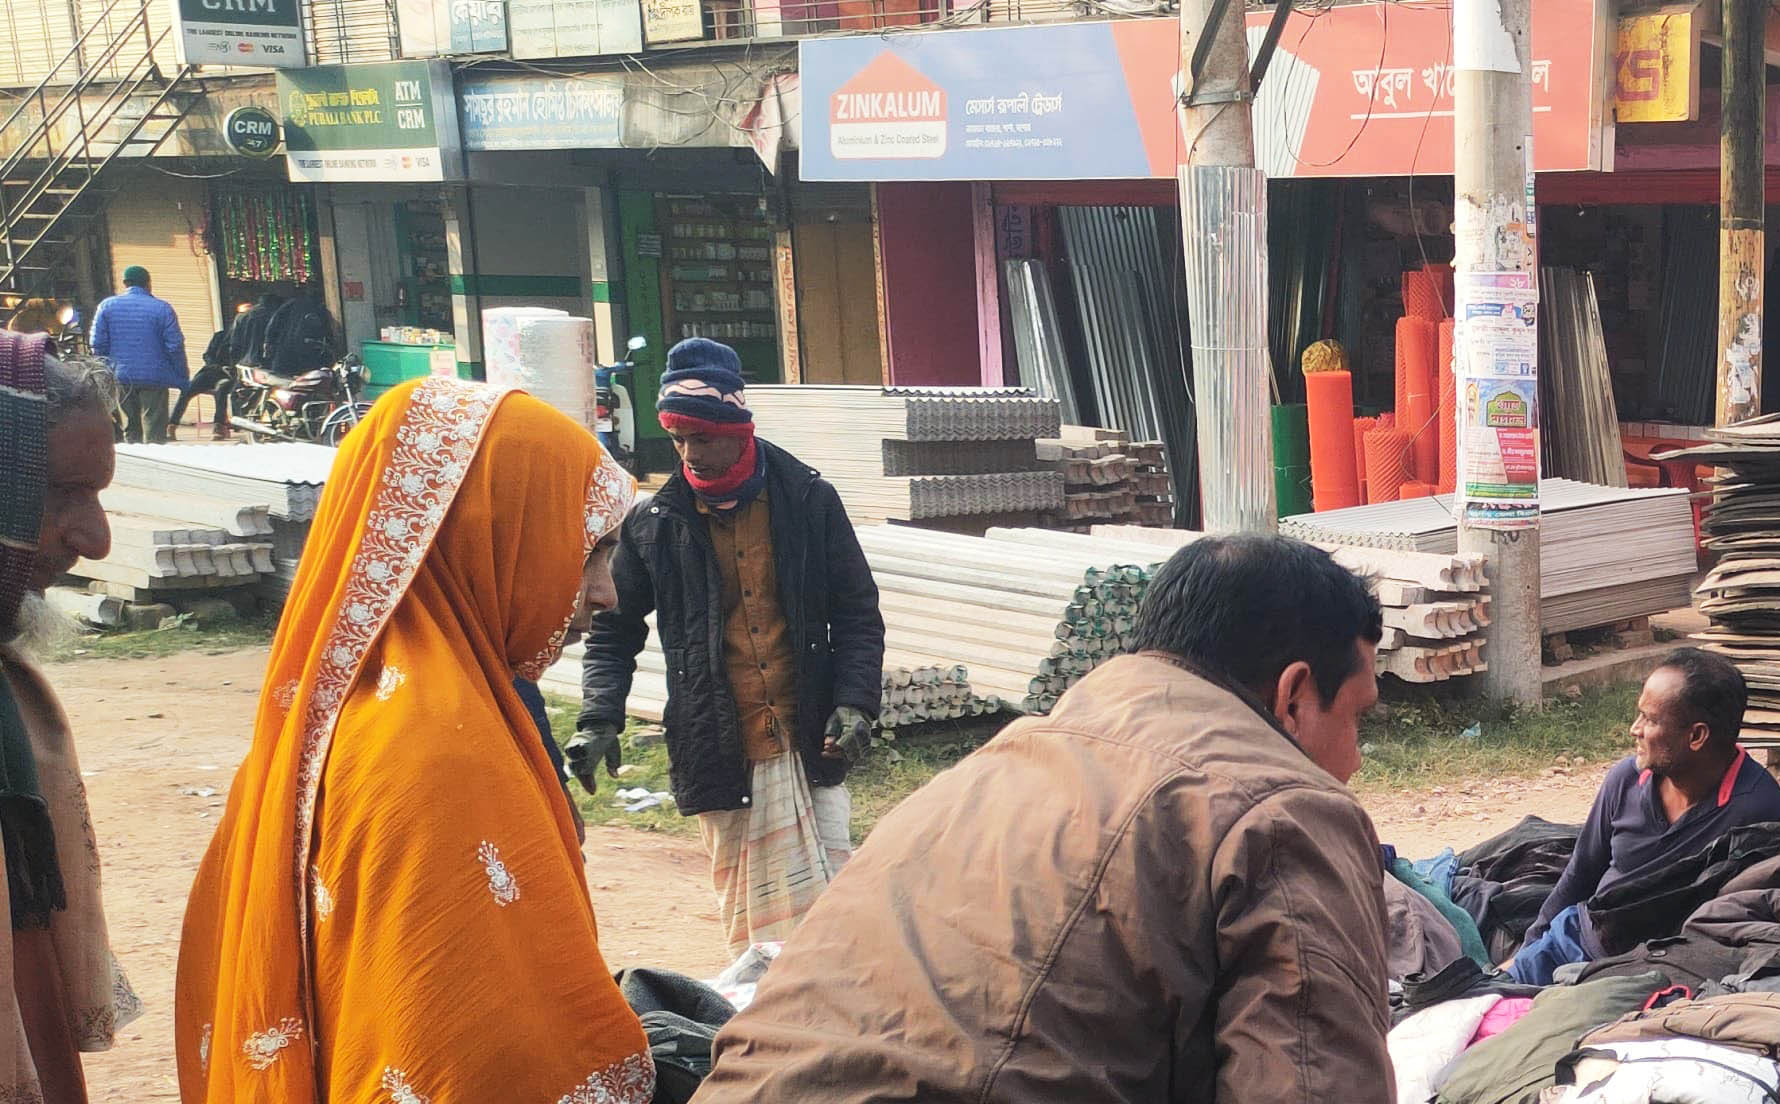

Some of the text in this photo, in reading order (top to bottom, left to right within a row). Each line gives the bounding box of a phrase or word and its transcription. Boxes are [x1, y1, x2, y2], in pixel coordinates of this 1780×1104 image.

[262, 44, 285, 54] VISA
[394, 81, 421, 100] ATM
[1352, 66, 1414, 110] আবুল
[836, 91, 941, 119] ZINKALUM
[307, 111, 339, 125] PUBALI
[340, 111, 364, 125] BANK
[398, 109, 426, 129] CRM
[234, 120, 272, 136] CRM
